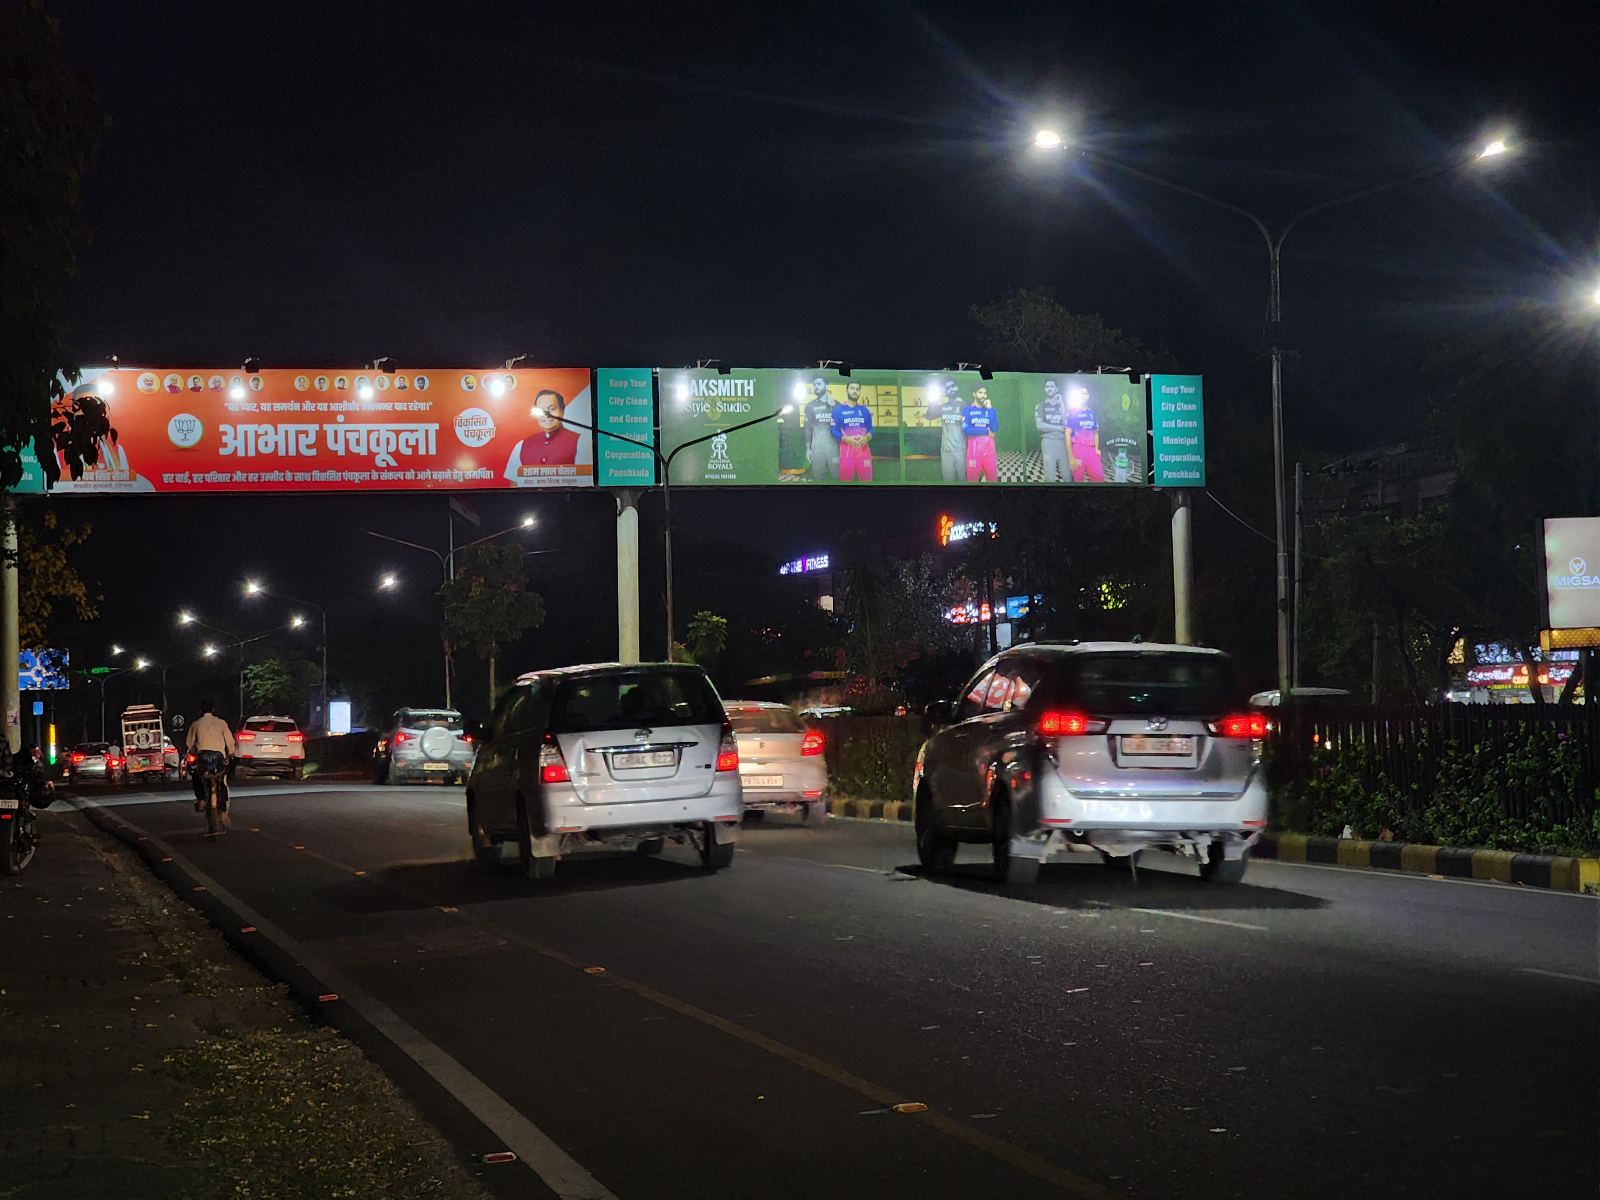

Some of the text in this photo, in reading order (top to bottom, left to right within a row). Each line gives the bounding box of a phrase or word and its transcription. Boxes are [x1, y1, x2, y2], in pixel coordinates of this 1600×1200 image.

[609, 379, 647, 389] Keep Your
[678, 378, 754, 397] AKSMITH
[1161, 384, 1195, 395] Keep Your
[609, 396, 648, 407] City Clean
[684, 402, 751, 418] Style Studio
[1161, 402, 1197, 413] City Clean
[454, 414, 488, 428] विकसित
[609, 414, 648, 424] and Green
[1162, 419, 1198, 428] and Green
[463, 426, 497, 442] पंचकूला
[219, 414, 440, 468] आभार पंचकूला
[1163, 436, 1198, 446] Municipal
[605, 450, 652, 461] Corporation,
[1160, 453, 1203, 463] Corporation,
[608, 468, 650, 478] Panchkula
[1163, 469, 1200, 479] Panchkula
